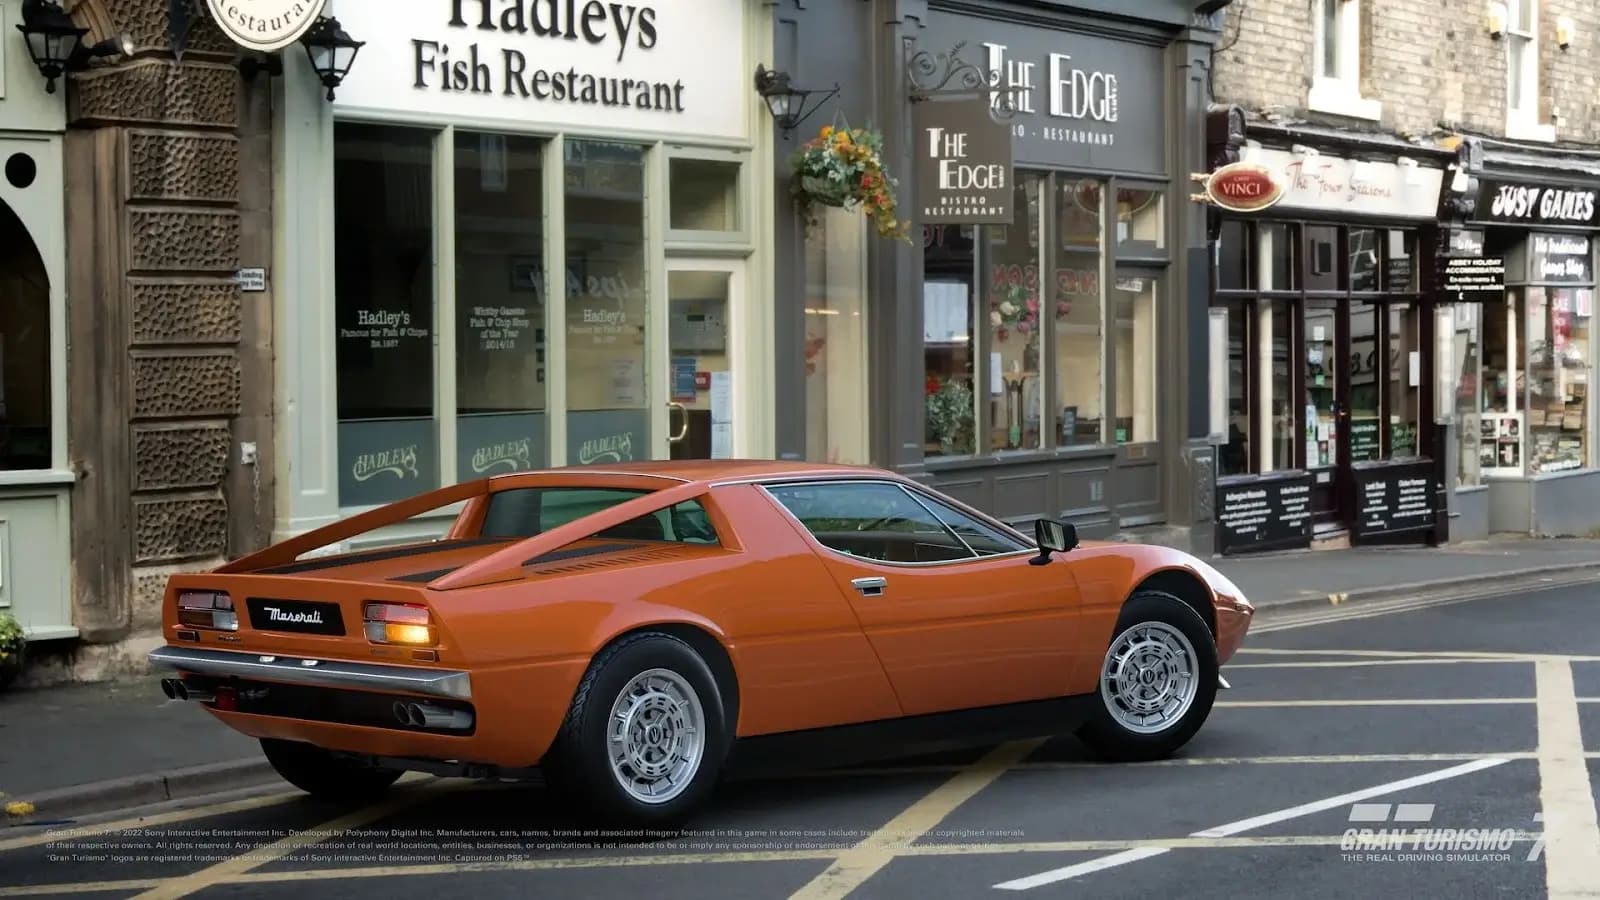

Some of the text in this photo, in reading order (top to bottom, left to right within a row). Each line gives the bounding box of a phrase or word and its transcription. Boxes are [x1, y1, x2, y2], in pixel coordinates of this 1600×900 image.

[220, 0, 311, 33] estaura
[447, 0, 657, 63] Hadleys
[411, 38, 685, 113] Fish Restaurant
[983, 42, 1036, 114] THE
[1049, 52, 1117, 123] EDGE
[925, 127, 968, 158] THE
[1043, 127, 1114, 146] RESTAURANT
[939, 159, 998, 190] EDGE
[1223, 183, 1260, 195] VINCI
[924, 207, 1004, 216] RESTAURANT
[940, 196, 986, 205] BISTRO
[1491, 185, 1595, 221] JUST GAMES
[357, 310, 410, 328] Hadley's
[264, 607, 324, 624] Maserati
